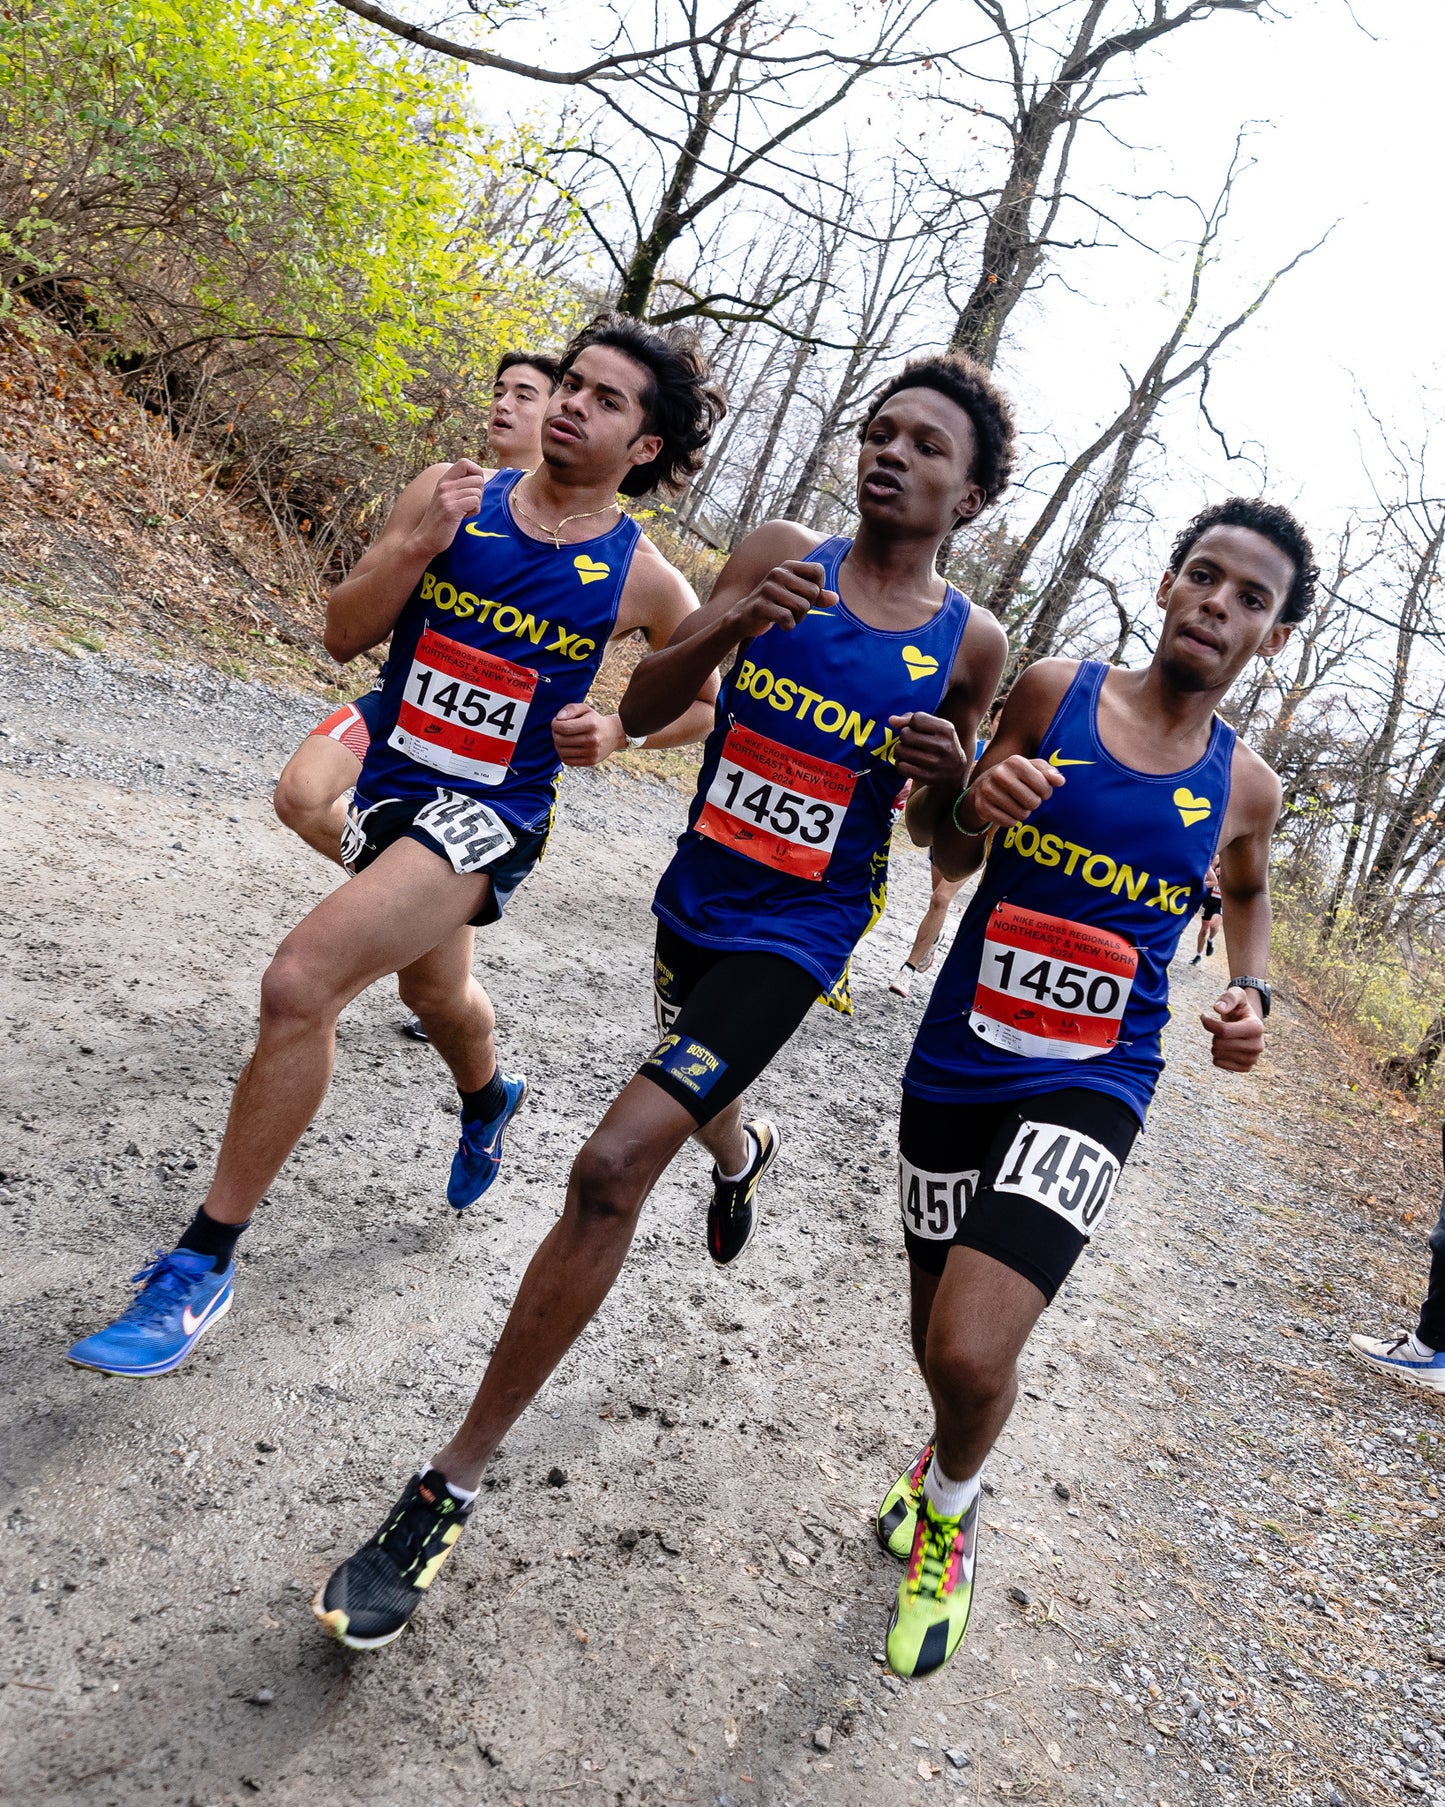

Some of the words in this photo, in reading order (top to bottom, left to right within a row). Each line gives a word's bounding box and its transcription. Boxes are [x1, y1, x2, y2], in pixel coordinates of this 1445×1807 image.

[419, 571, 549, 644] BOSTON
[545, 625, 595, 661] XC
[420, 643, 471, 670] NORTHEAST
[472, 665, 478, 673] &
[481, 668, 503, 681] NEW
[506, 677, 534, 692] YORK
[433, 641, 449, 651] NIKE
[451, 647, 477, 662] CROSS
[478, 656, 521, 678] REGIONALS
[460, 671, 481, 684] 2024
[415, 669, 517, 737] 1454
[735, 659, 875, 747] BOSTON
[729, 740, 784, 771] NORTHEAST
[785, 766, 792, 775] &
[795, 768, 819, 785] NEW
[823, 778, 851, 794] YORK
[744, 737, 761, 750] NIKE
[763, 745, 790, 762] CROSS
[792, 756, 840, 780] REGIONALS
[771, 772, 795, 786] 2024
[418, 789, 504, 867] 1454
[725, 770, 835, 844] 1453
[1003, 820, 1149, 901] BOSTON
[1145, 878, 1191, 915] XC
[993, 919, 1061, 945] NORTHEAST
[1064, 940, 1072, 949] &
[1074, 943, 1101, 956] NEW
[1102, 950, 1135, 966] YORK
[1012, 914, 1034, 927] NIKE
[1036, 921, 1067, 935] CROSS
[1069, 930, 1121, 949] REGIONALS
[1050, 947, 1074, 960] 2024
[994, 950, 1119, 1014] 1450
[686, 1043, 719, 1072] BOSTON
[900, 1161, 974, 1235] 450
[1004, 1129, 1114, 1227] 1450
